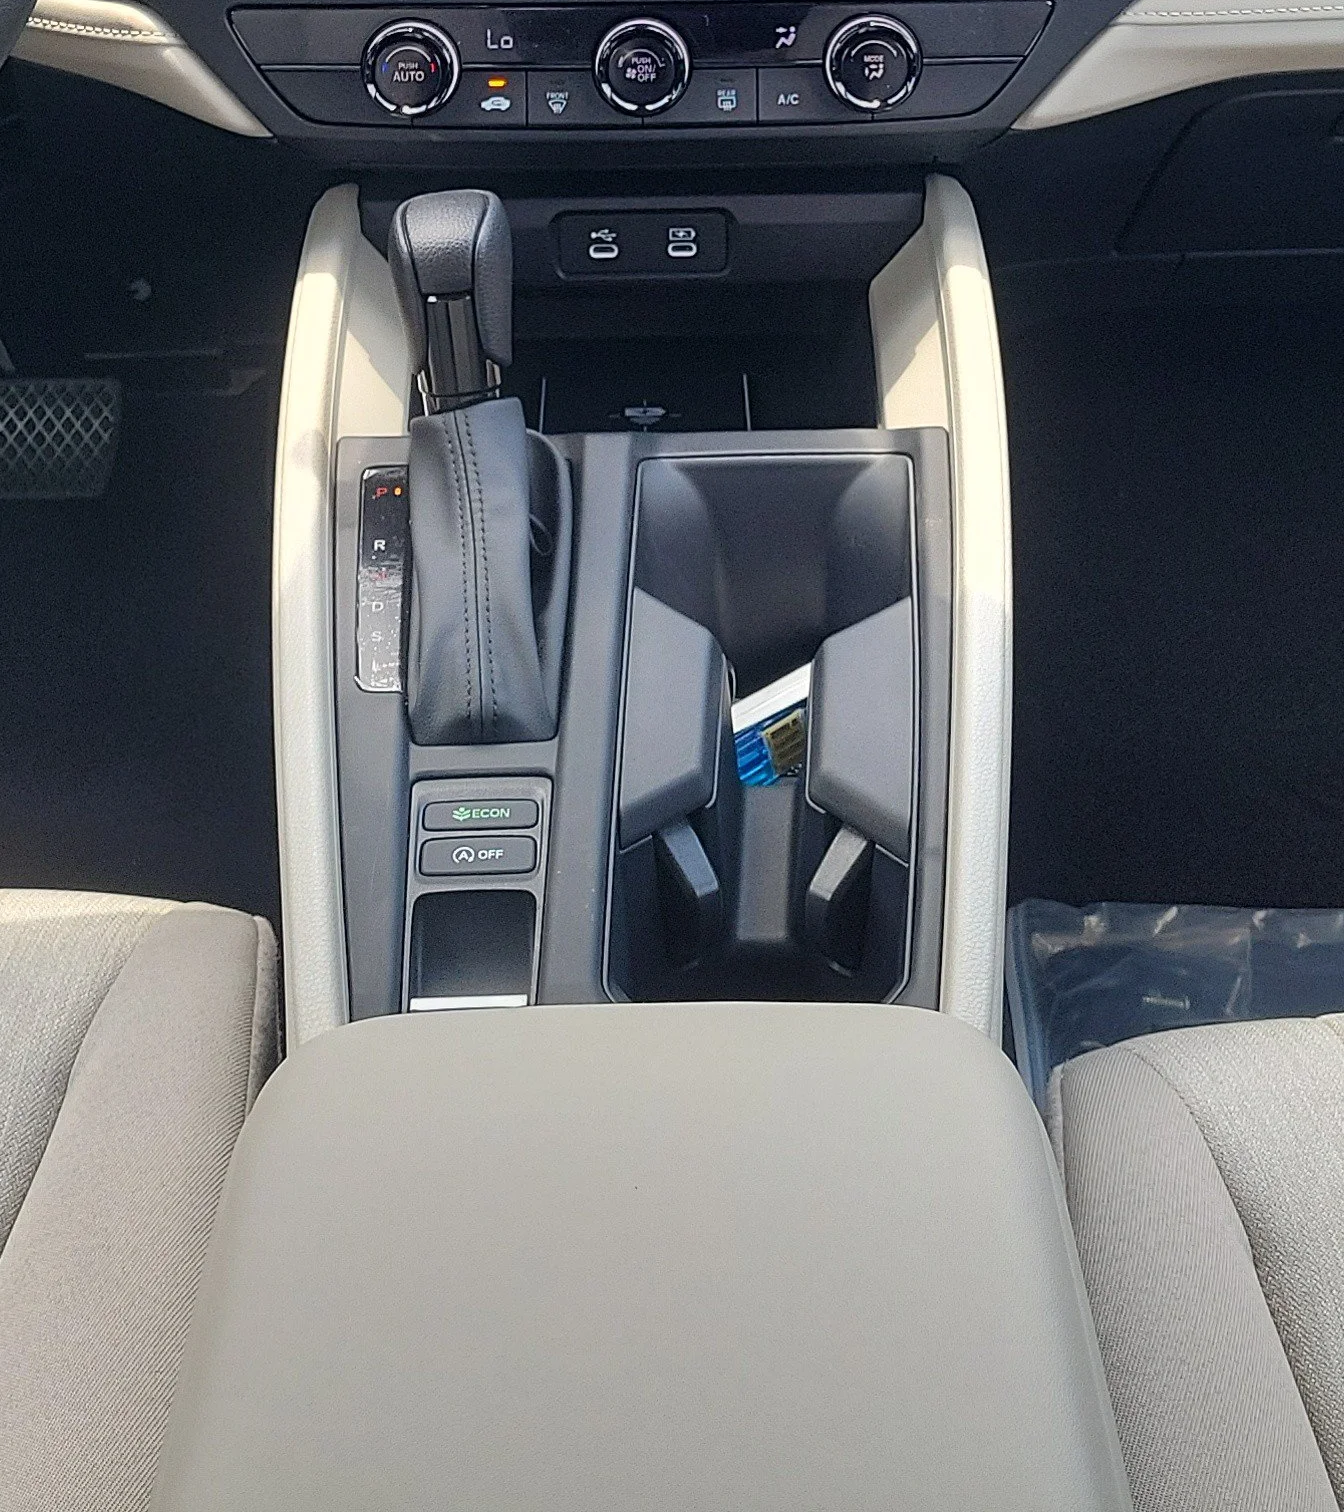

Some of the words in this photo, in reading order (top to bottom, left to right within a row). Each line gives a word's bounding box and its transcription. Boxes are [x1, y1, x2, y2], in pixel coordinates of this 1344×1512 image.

[398, 62, 419, 70] PUSH
[632, 57, 651, 65] PUSH
[393, 71, 424, 82] AUTO
[637, 73, 656, 83] OFF
[546, 91, 568, 100] FRONT
[777, 92, 799, 105] A/C
[373, 539, 386, 551] R
[371, 601, 384, 612] D
[371, 631, 382, 642] S
[472, 808, 510, 819] ECON
[478, 849, 504, 860] OFF
